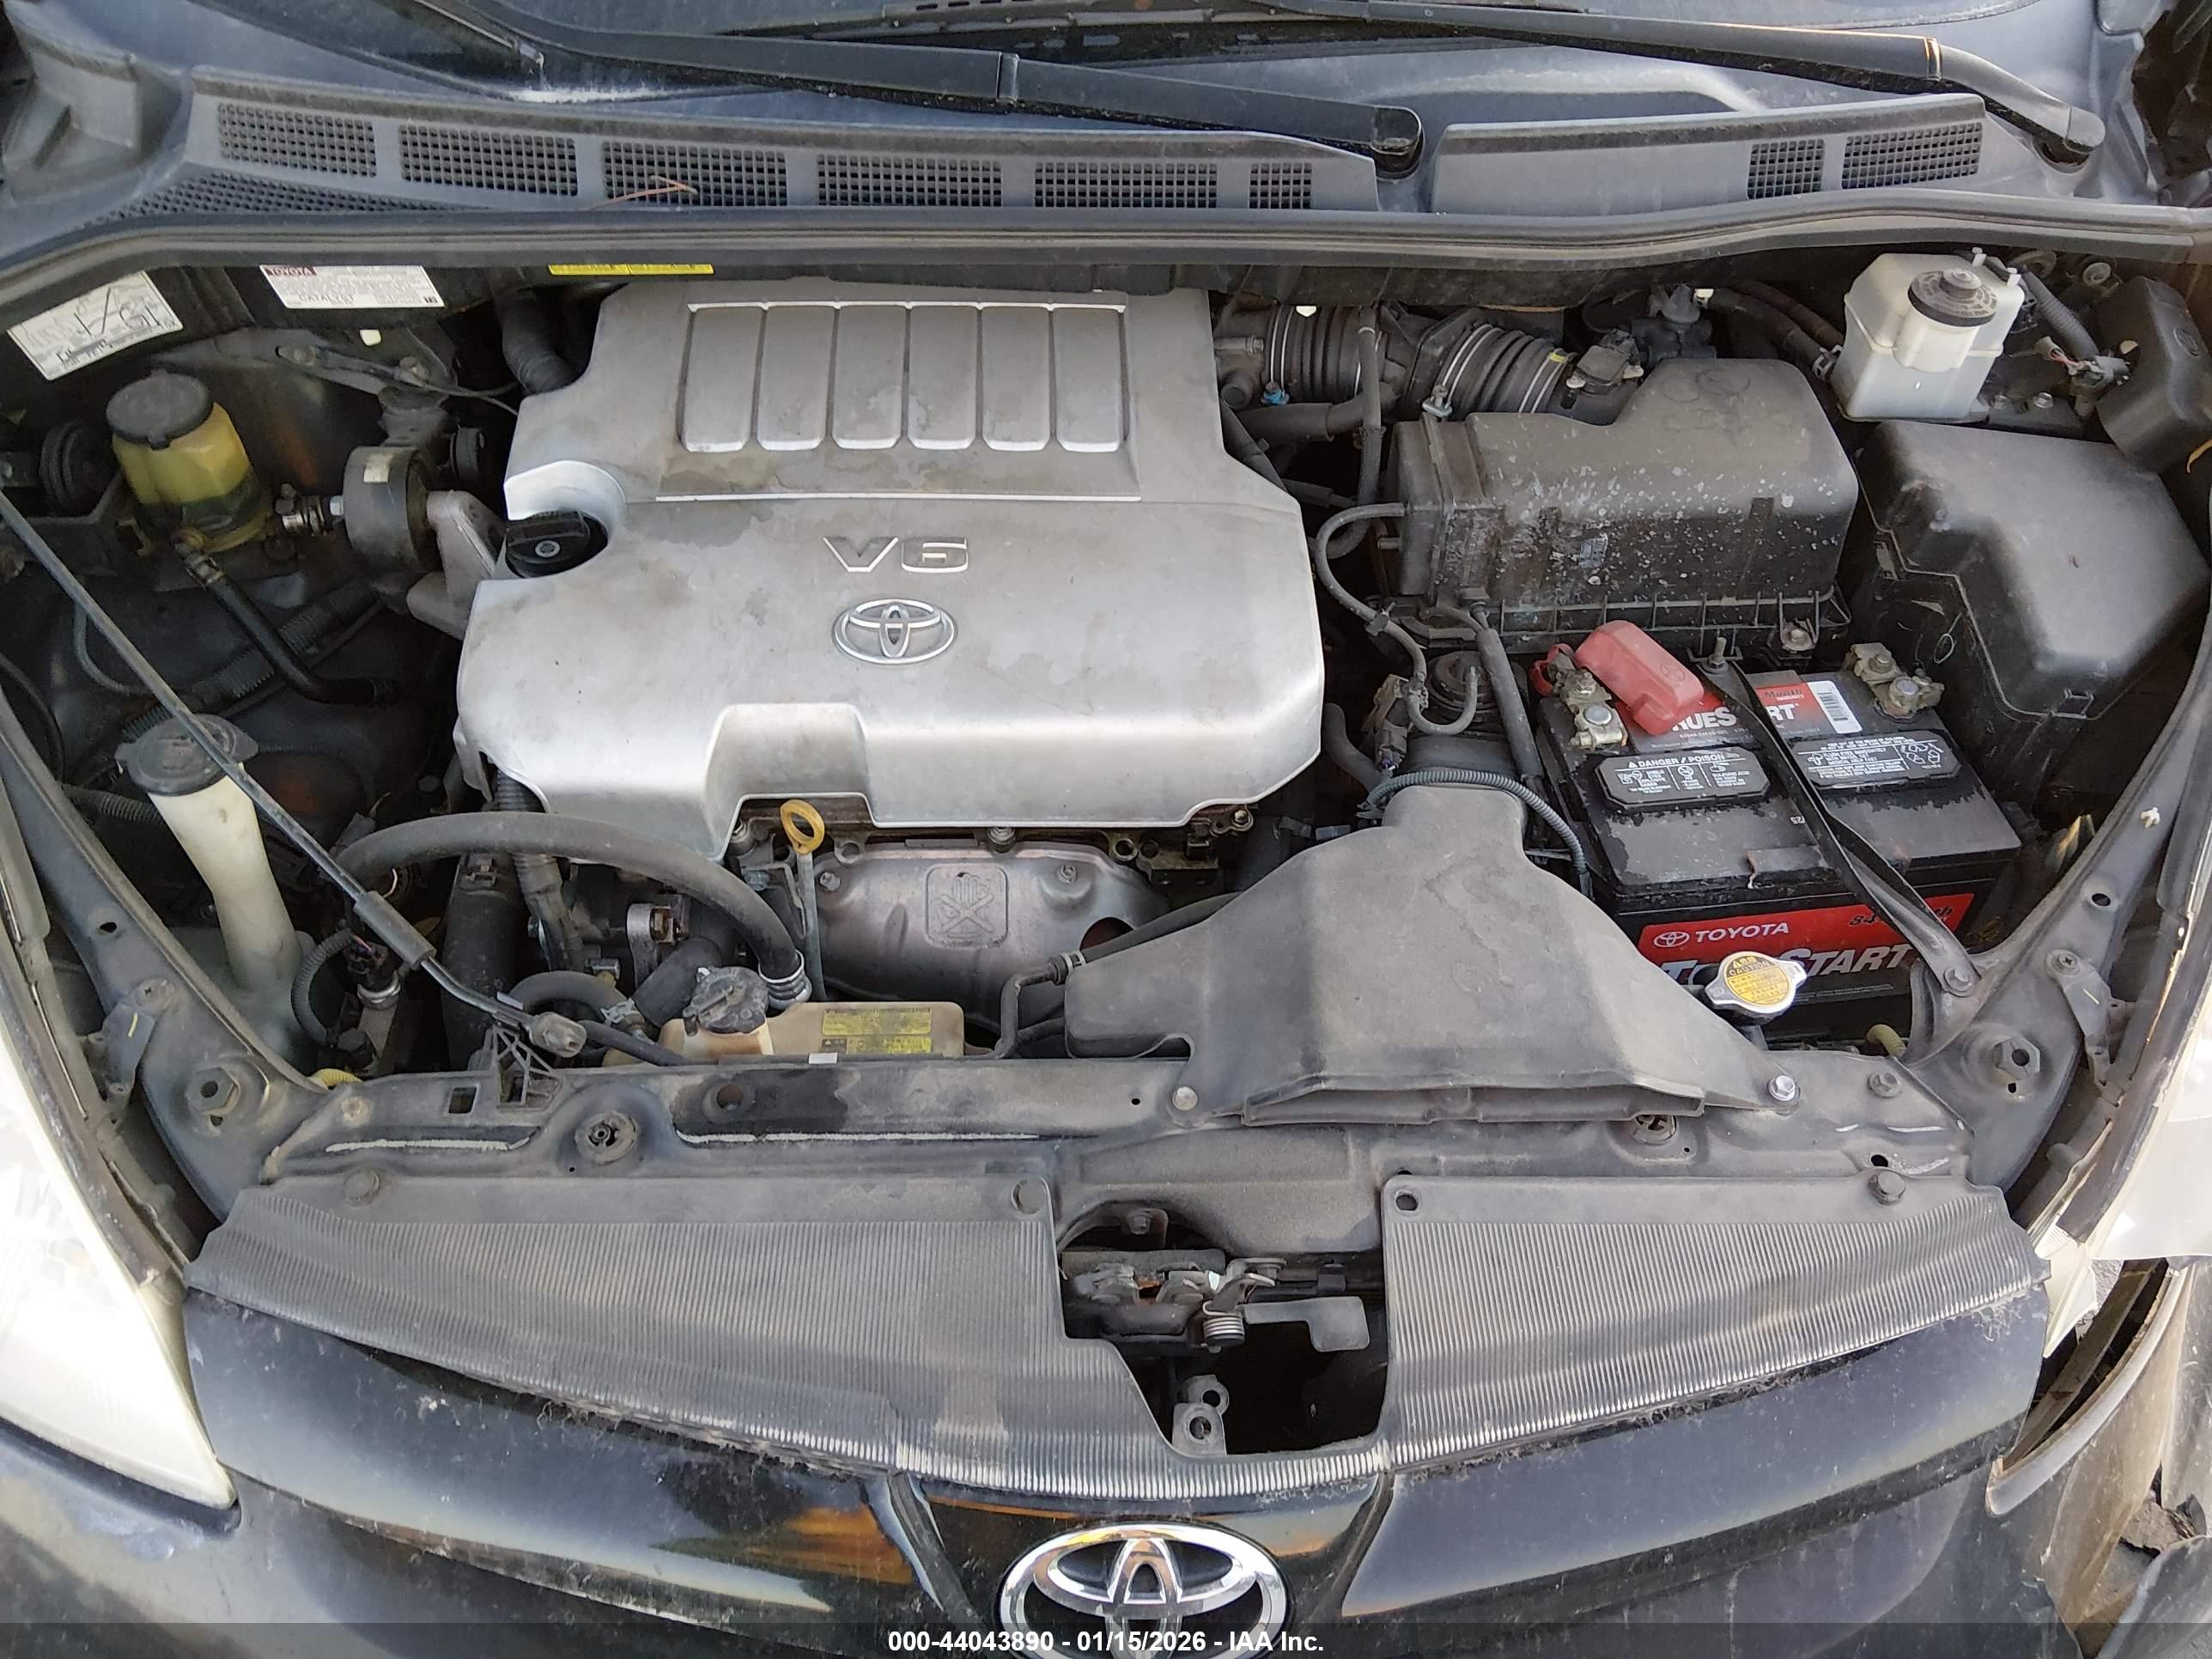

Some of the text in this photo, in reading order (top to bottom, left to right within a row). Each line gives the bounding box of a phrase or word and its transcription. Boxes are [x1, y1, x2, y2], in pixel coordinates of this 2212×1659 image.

[263, 266, 314, 275] TOYOTA
[822, 536, 969, 574] V6
[1638, 757, 1680, 768] DANGER
[1687, 754, 1726, 763] POISON
[1695, 922, 1790, 943] TOYOTA
[1729, 961, 1771, 976] CAUTION
